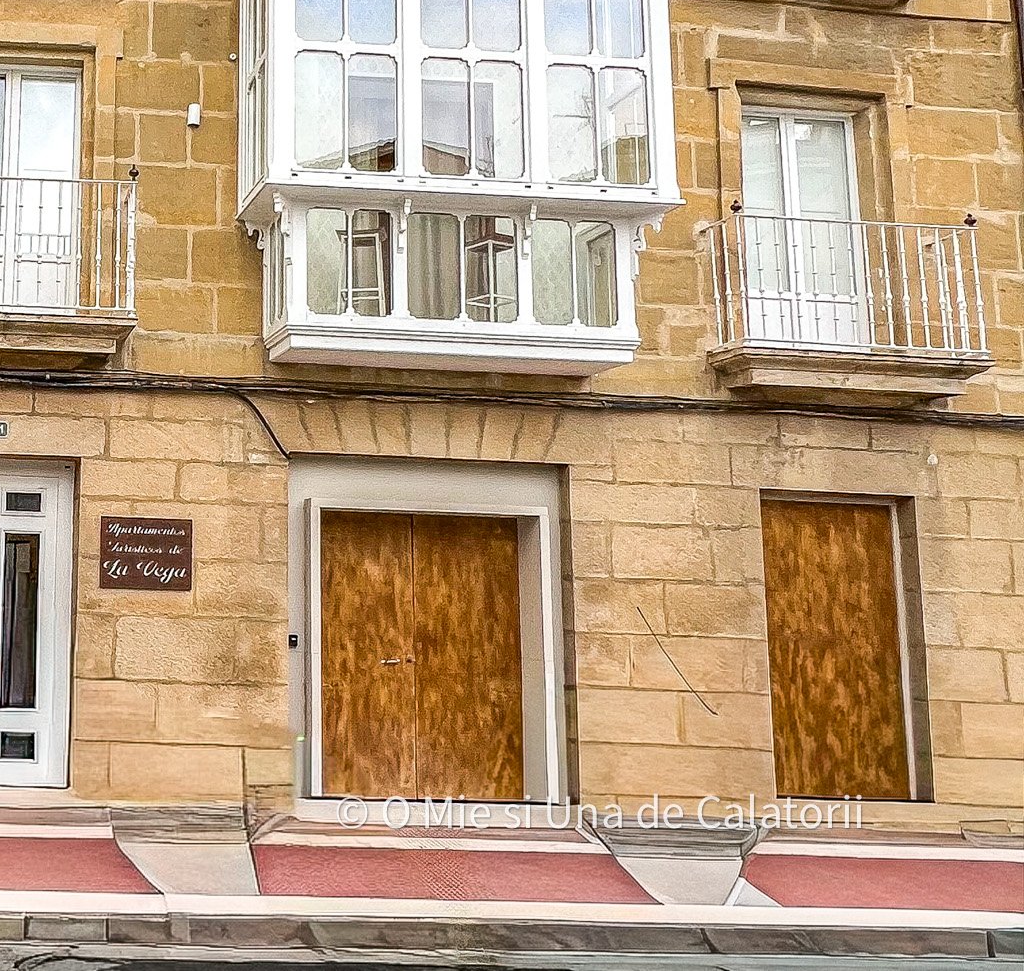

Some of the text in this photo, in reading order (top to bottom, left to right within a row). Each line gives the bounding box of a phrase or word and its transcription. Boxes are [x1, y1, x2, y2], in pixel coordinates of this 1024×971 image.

[106, 523, 186, 538] Apartamentos
[103, 558, 187, 584] La Vega
